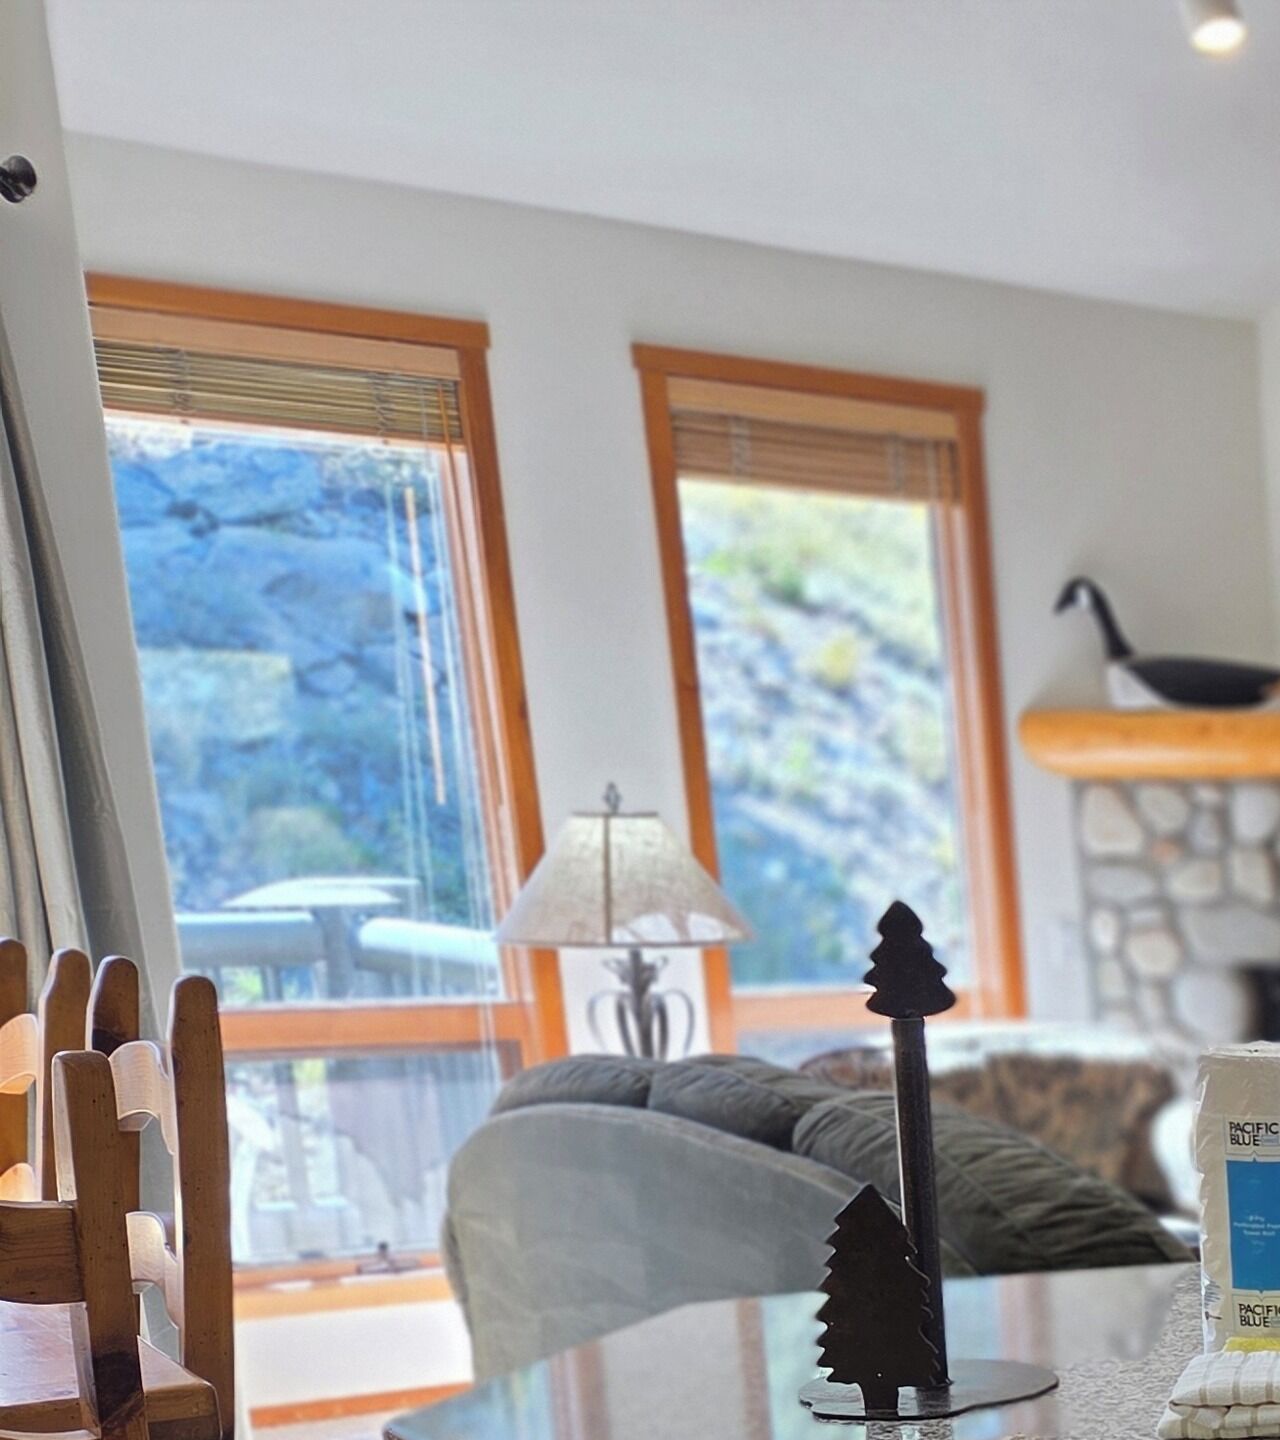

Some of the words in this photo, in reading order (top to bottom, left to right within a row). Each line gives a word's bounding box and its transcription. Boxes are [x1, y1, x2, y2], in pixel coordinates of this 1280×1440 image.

[1229, 1122, 1279, 1135] PACIFIC
[1230, 1134, 1260, 1146] BLUE
[1239, 1315, 1270, 1328] BLUE
